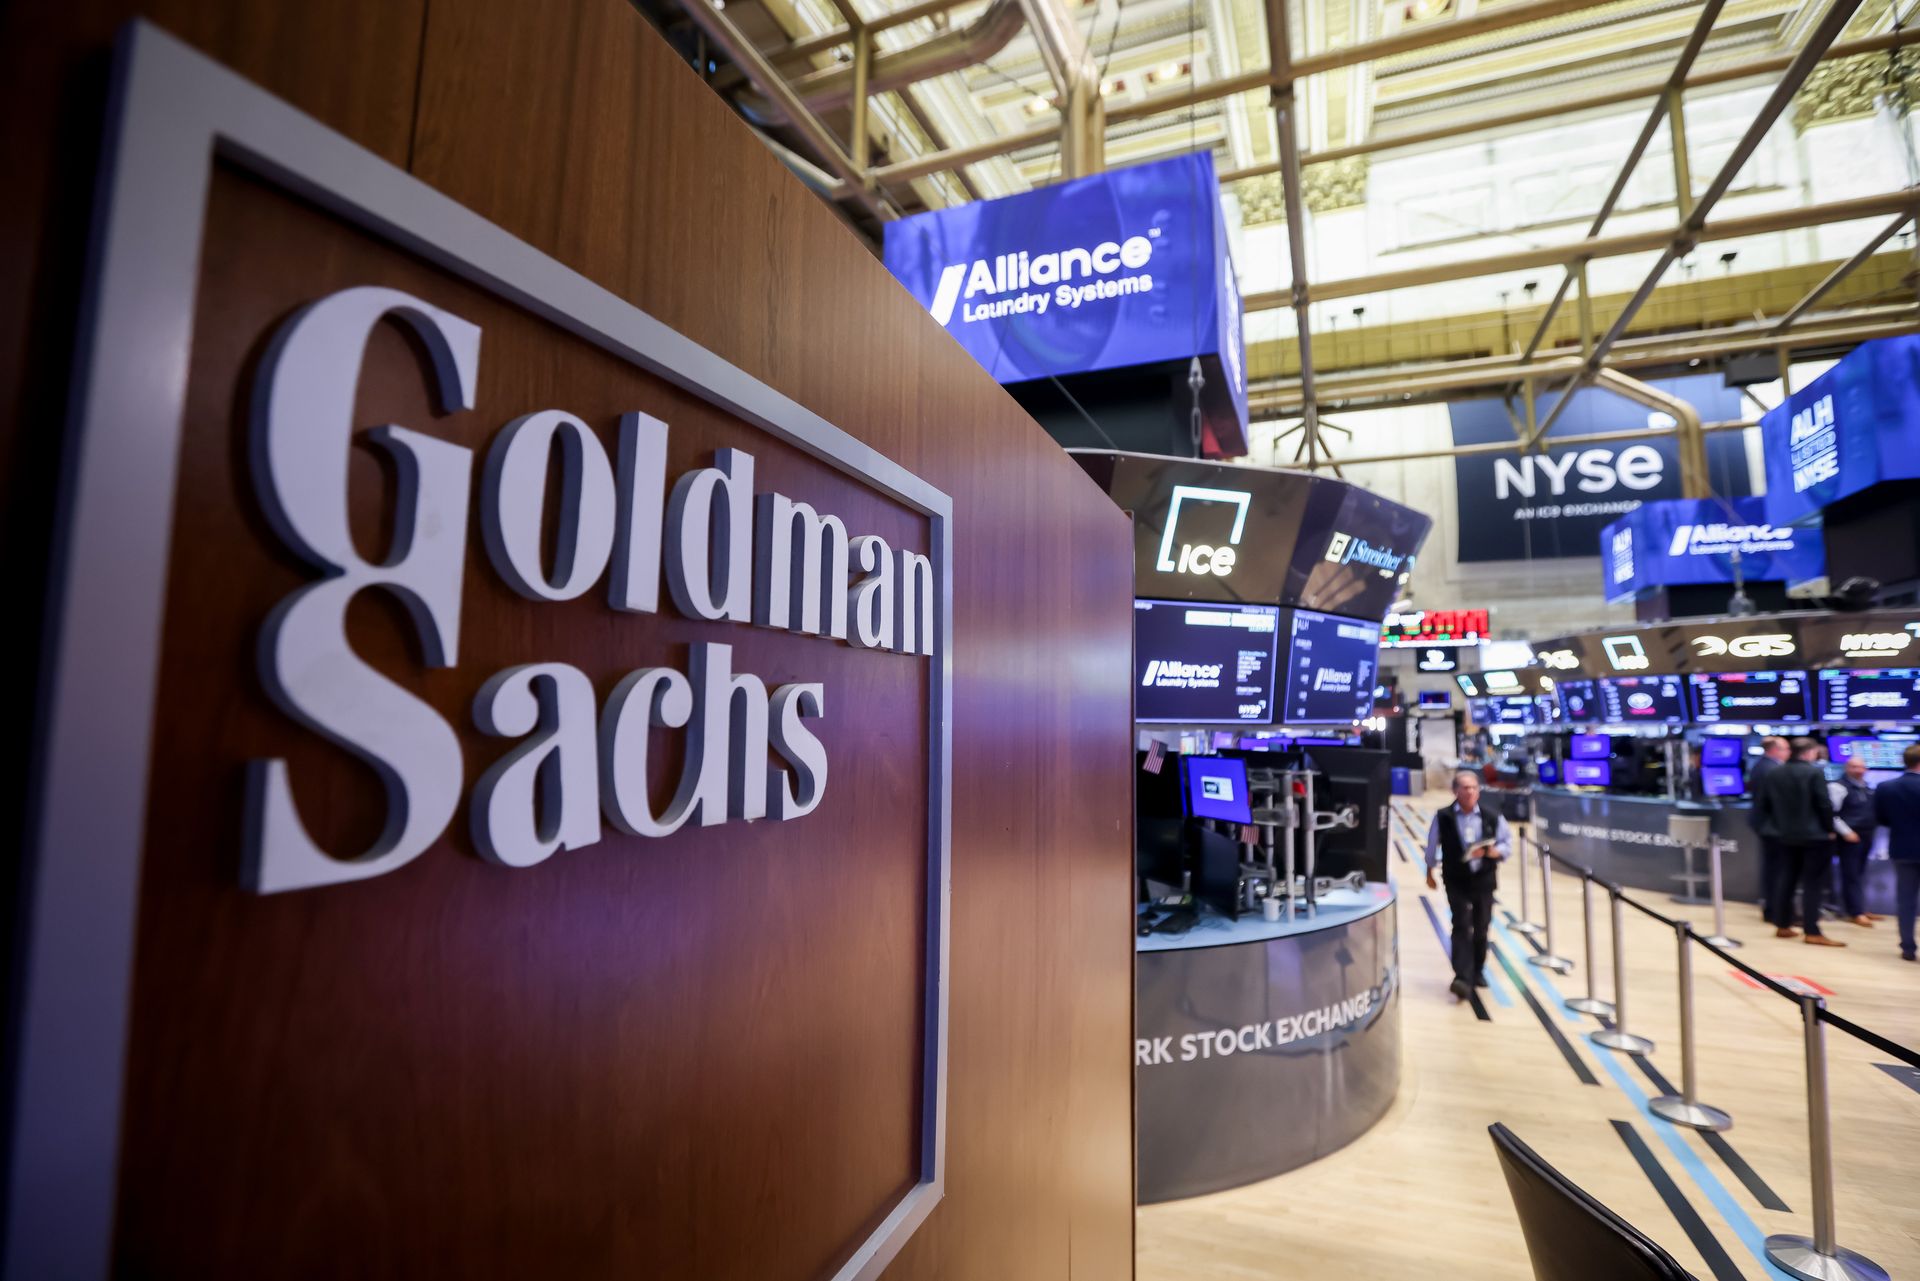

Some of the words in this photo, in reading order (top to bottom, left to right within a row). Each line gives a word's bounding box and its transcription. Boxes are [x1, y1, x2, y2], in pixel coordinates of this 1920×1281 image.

[963, 236, 1153, 300] Alliance
[963, 291, 1051, 323] Laundry
[1055, 274, 1153, 308] Systems
[1790, 394, 1834, 446] ALH
[249, 286, 935, 668] Goldman
[1157, 660, 1221, 679] Alliance
[240, 575, 828, 895] Sachs
[1179, 1020, 1273, 1063] STOCK
[1275, 988, 1373, 1047] EXCHANGE
